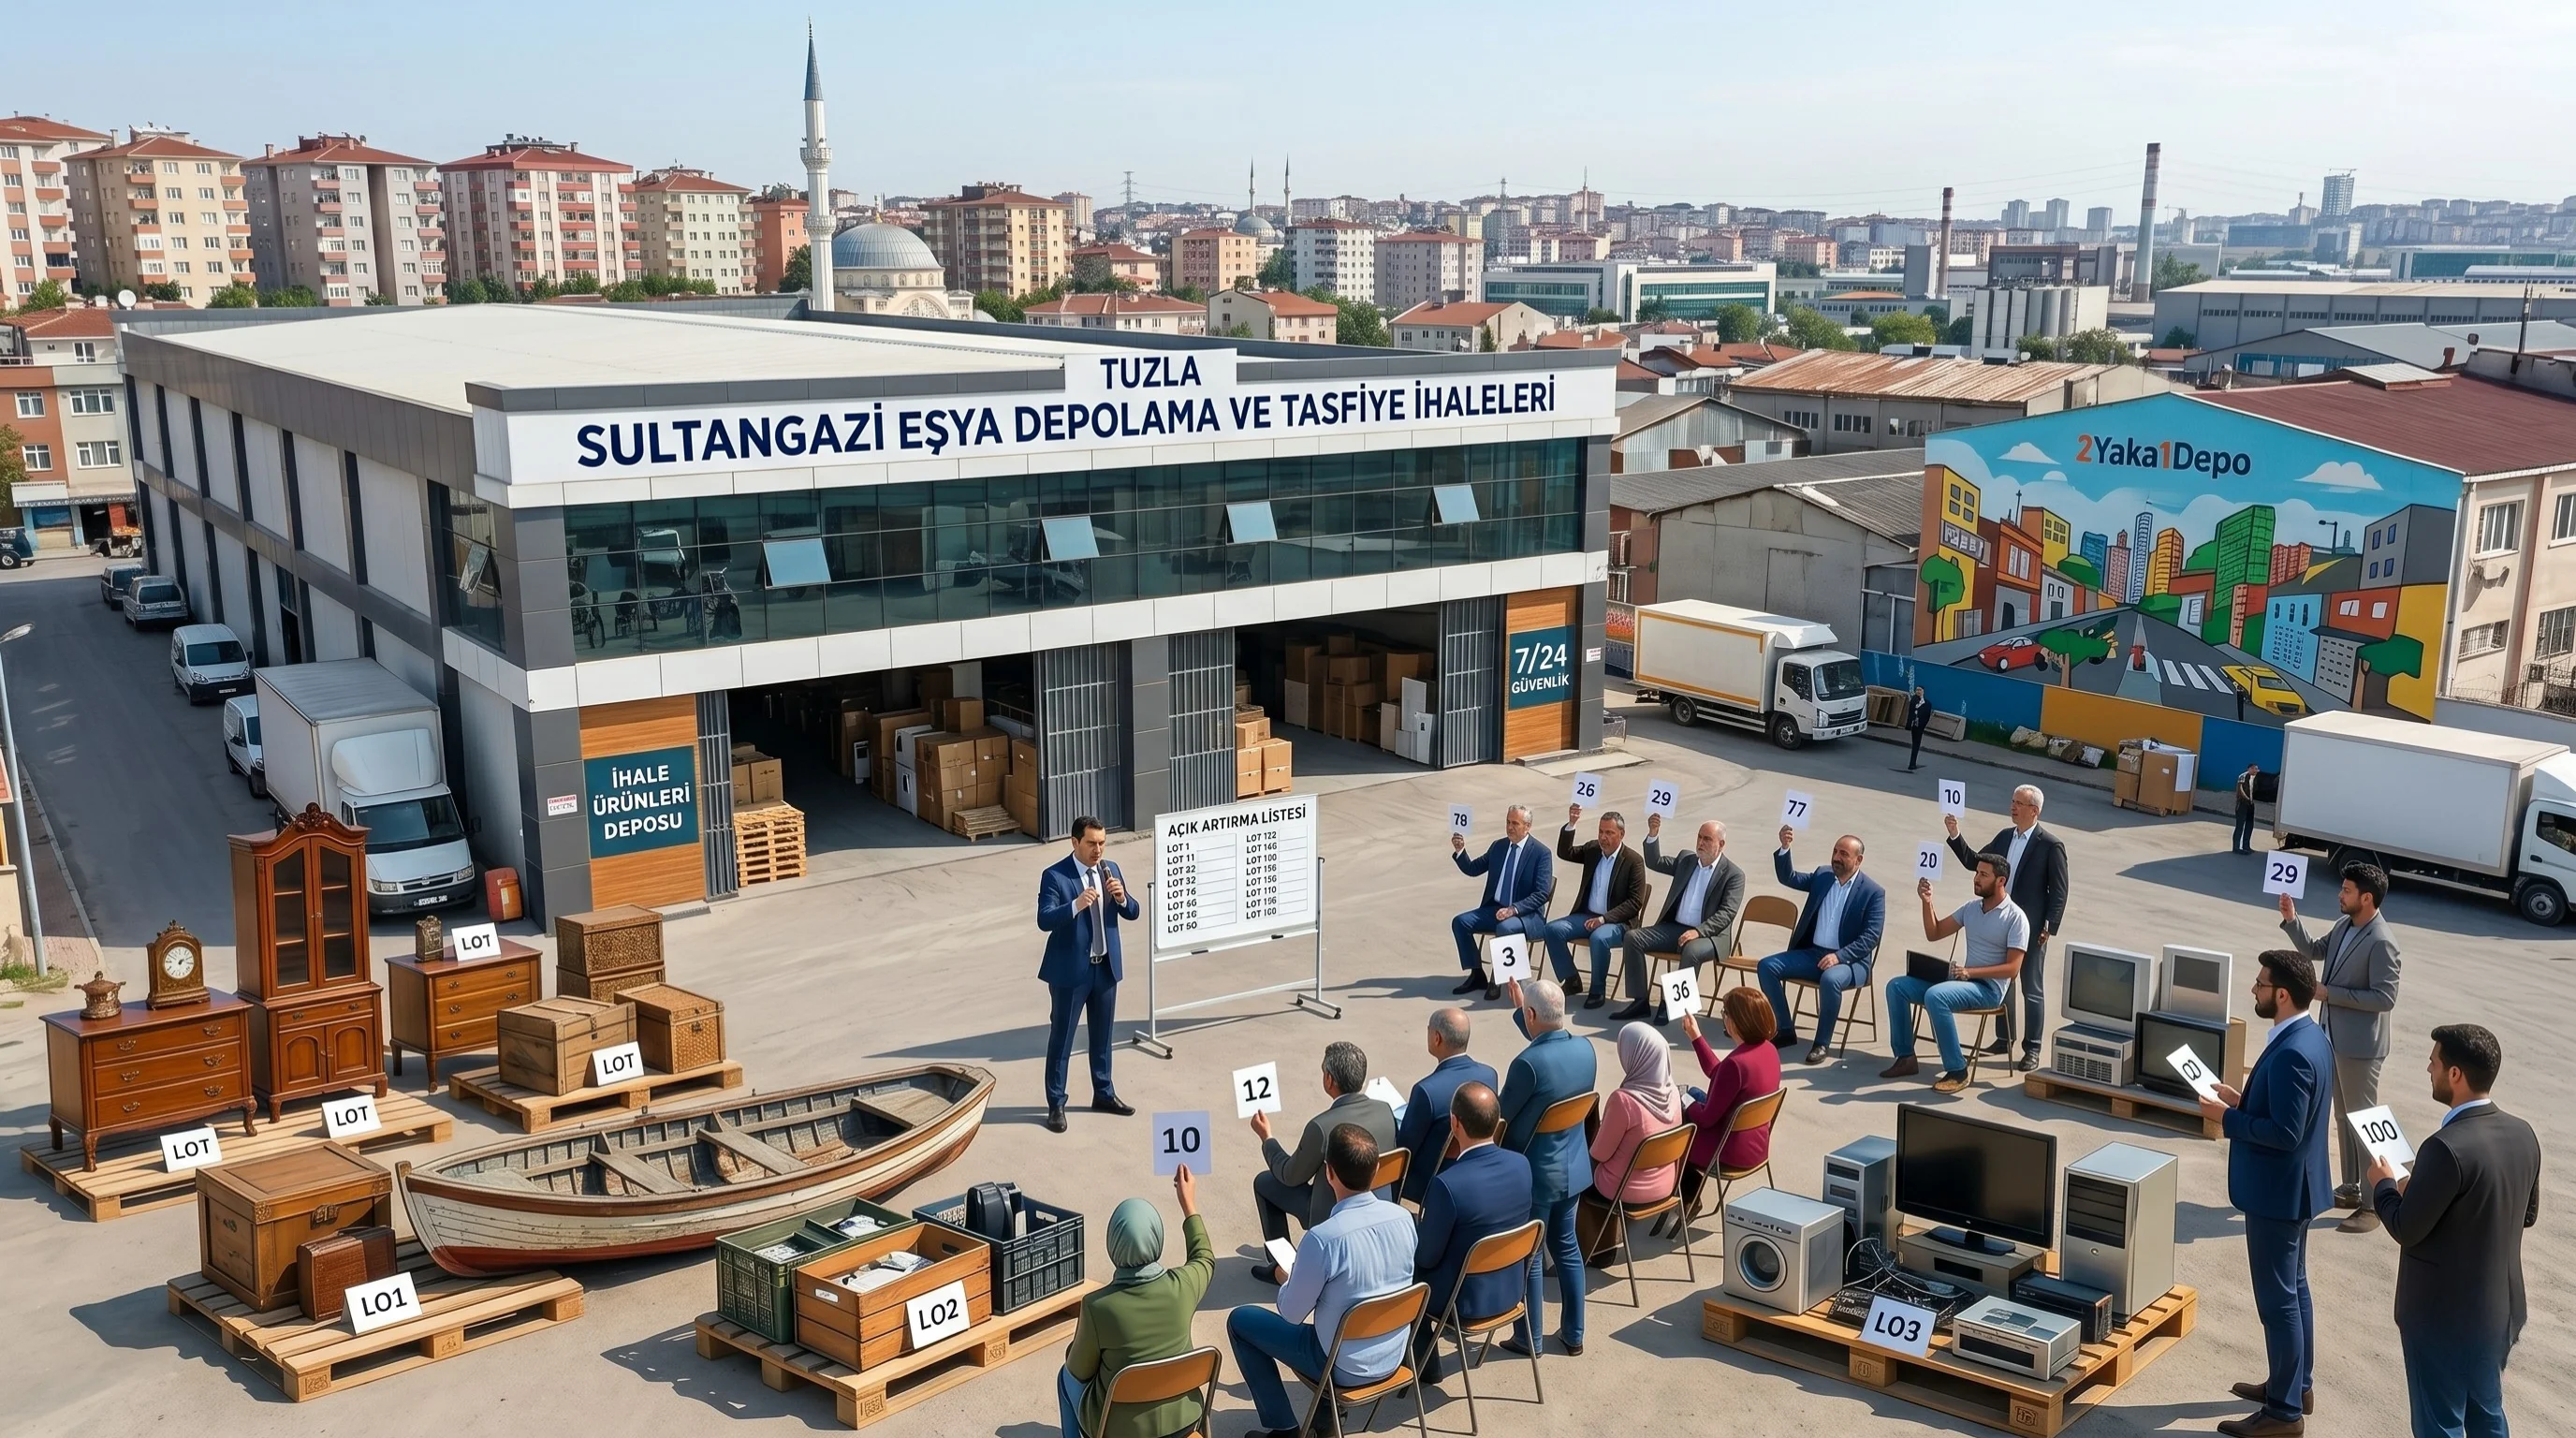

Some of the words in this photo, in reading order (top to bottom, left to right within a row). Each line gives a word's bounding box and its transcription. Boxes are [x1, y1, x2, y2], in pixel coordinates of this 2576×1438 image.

[1100, 356, 1201, 389] TUZLA
[578, 403, 884, 467] SULTANGAZİ
[900, 408, 1003, 455] EŞYA
[1015, 399, 1220, 442] DEPOLAMA
[1230, 396, 1270, 430] VE
[1281, 383, 1405, 426] TASFİYE
[1415, 374, 1554, 418] İHALELERİ
[2076, 434, 2251, 479] 2Yaka1Depo
[1515, 642, 1567, 674] 7/24
[1512, 672, 1570, 694] GÜVENLİK
[612, 765, 669, 788] İHALE
[1577, 782, 1594, 797] 26
[1652, 790, 1671, 805] 29
[1945, 789, 1960, 804] 10
[593, 782, 691, 815] ÜRÜNLERİ
[1788, 800, 1807, 816] 77
[604, 812, 682, 840] DEPOSU
[1168, 821, 1198, 838] AÇIK
[1202, 814, 1259, 832] ARTIRMA
[1262, 803, 1307, 824] LİSTESİ
[1455, 814, 1467, 826] 78
[1247, 834, 1262, 843] LOT
[1264, 831, 1277, 840] 122
[1167, 844, 1183, 853] LOT
[1247, 844, 1262, 854] LOT
[1167, 856, 1183, 865] LOT
[1247, 856, 1262, 865] LOT
[1920, 852, 1937, 868] 20
[1167, 867, 1183, 876] LOT
[1247, 867, 1262, 875] LOT
[2271, 863, 2297, 883] 29
[1167, 878, 1183, 888] LOT
[1247, 877, 1262, 887] LOT
[1167, 889, 1183, 899] LOT
[1247, 888, 1261, 897] LOT
[1168, 901, 1184, 910] LOT
[1247, 900, 1261, 908] LOT
[1168, 913, 1184, 922] LOT
[1247, 910, 1261, 919] LOT
[1168, 924, 1184, 932] LOT
[461, 934, 490, 950] LOT
[1502, 947, 1515, 966] 3
[1673, 980, 1690, 1001] 36
[604, 1053, 634, 1074] LOT
[1243, 1077, 1271, 1102] 12
[335, 1106, 367, 1126] LOT
[2362, 1120, 2397, 1143] 100
[1164, 1127, 1200, 1153] 10
[173, 1138, 209, 1159] LOT
[361, 1288, 407, 1316] LO1
[919, 1299, 959, 1330] LO2
[1875, 1312, 1921, 1342] LO3
